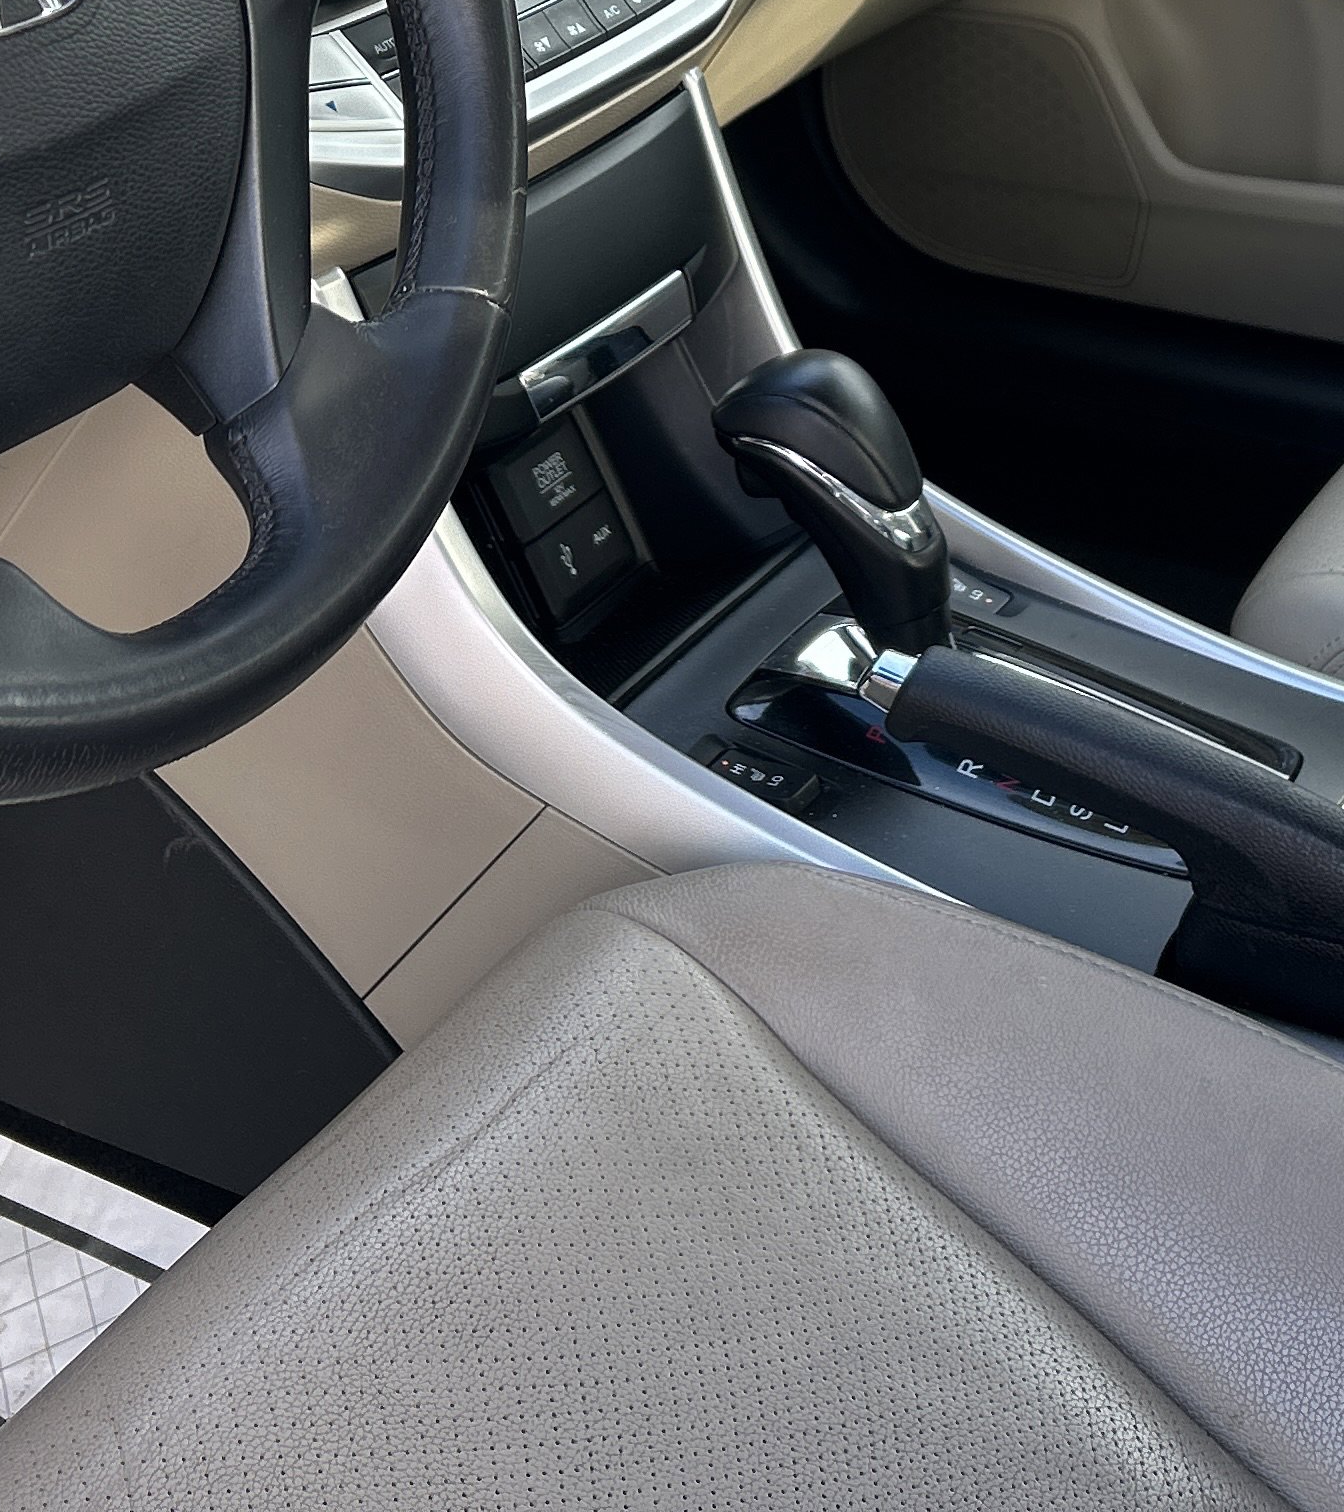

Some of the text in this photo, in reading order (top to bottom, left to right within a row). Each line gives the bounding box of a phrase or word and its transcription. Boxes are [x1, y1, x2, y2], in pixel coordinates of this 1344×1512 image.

[22, 176, 111, 234] SRS
[592, 524, 613, 545] AUX
[956, 758, 984, 779] R
